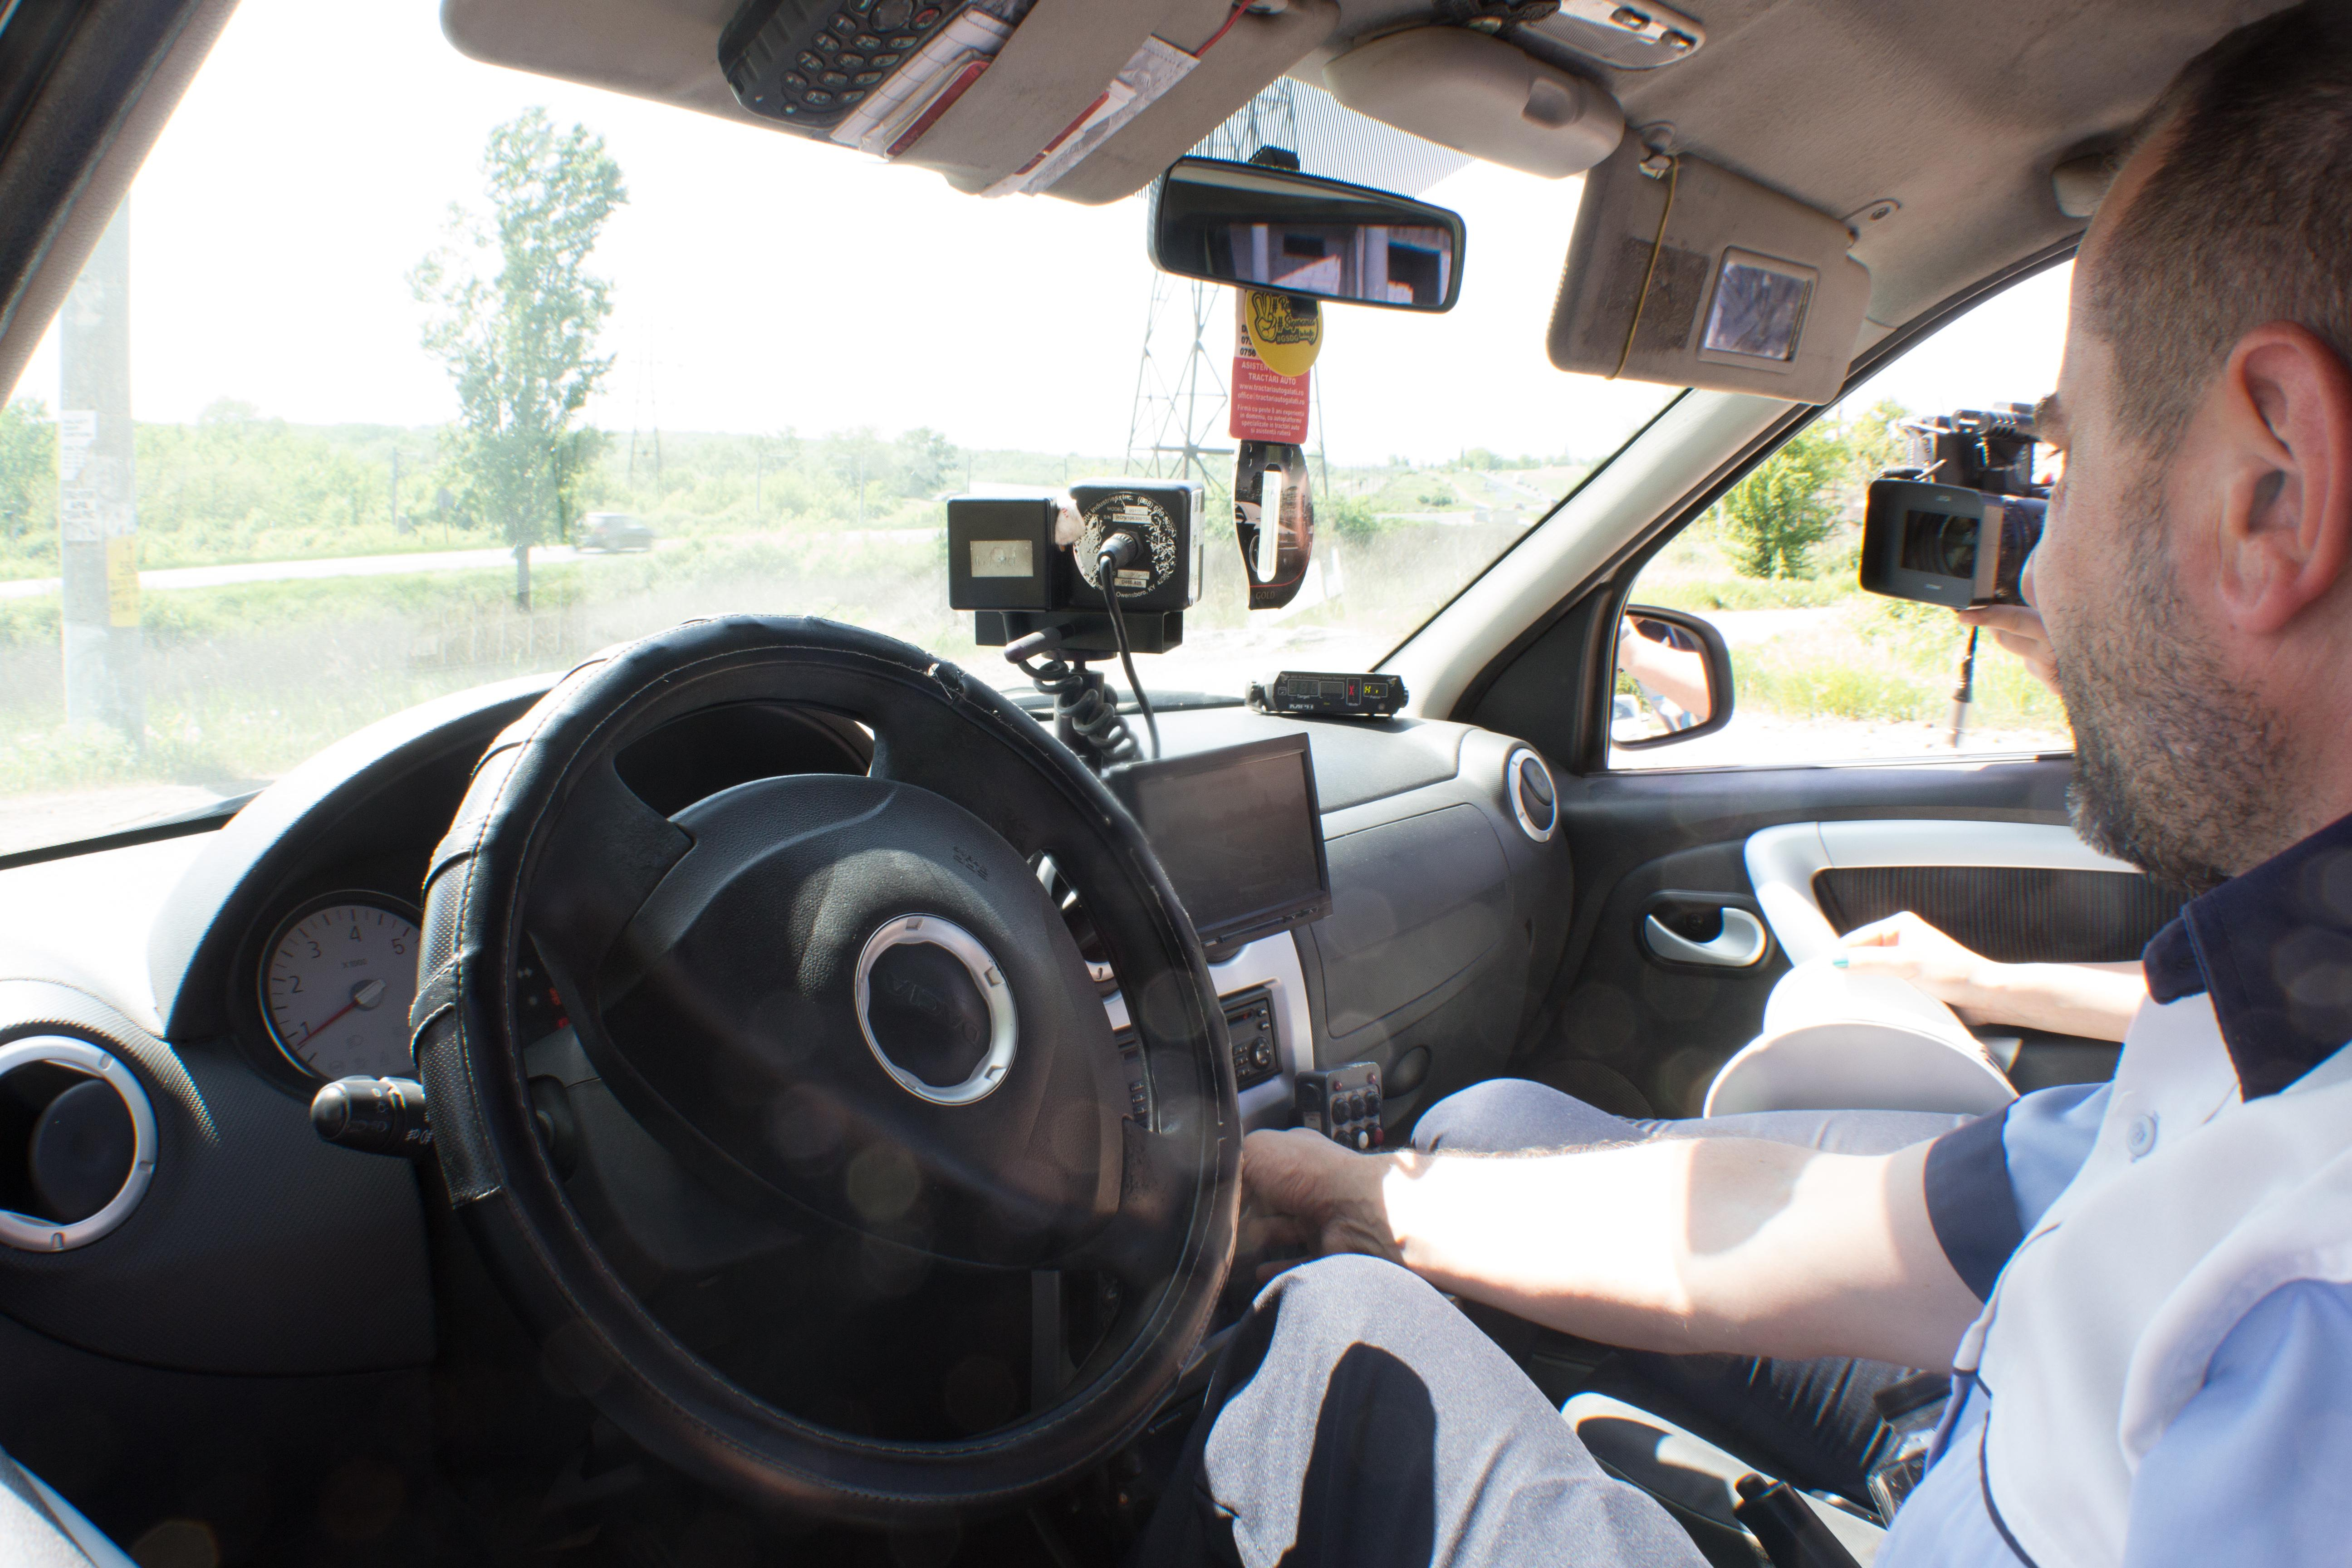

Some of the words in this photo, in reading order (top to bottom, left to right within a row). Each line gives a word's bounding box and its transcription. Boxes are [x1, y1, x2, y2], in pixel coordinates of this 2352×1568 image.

[1280, 376, 1296, 385] AUTO
[1239, 384, 1304, 396] www.tractariautogalati.ro
[1147, 584, 1156, 593] KY
[1255, 591, 1275, 600] GOLD
[350, 925, 362, 942] 4
[308, 941, 321, 958] 3
[391, 938, 405, 955] 5
[289, 975, 304, 994] 2
[300, 1021, 311, 1036] 1
